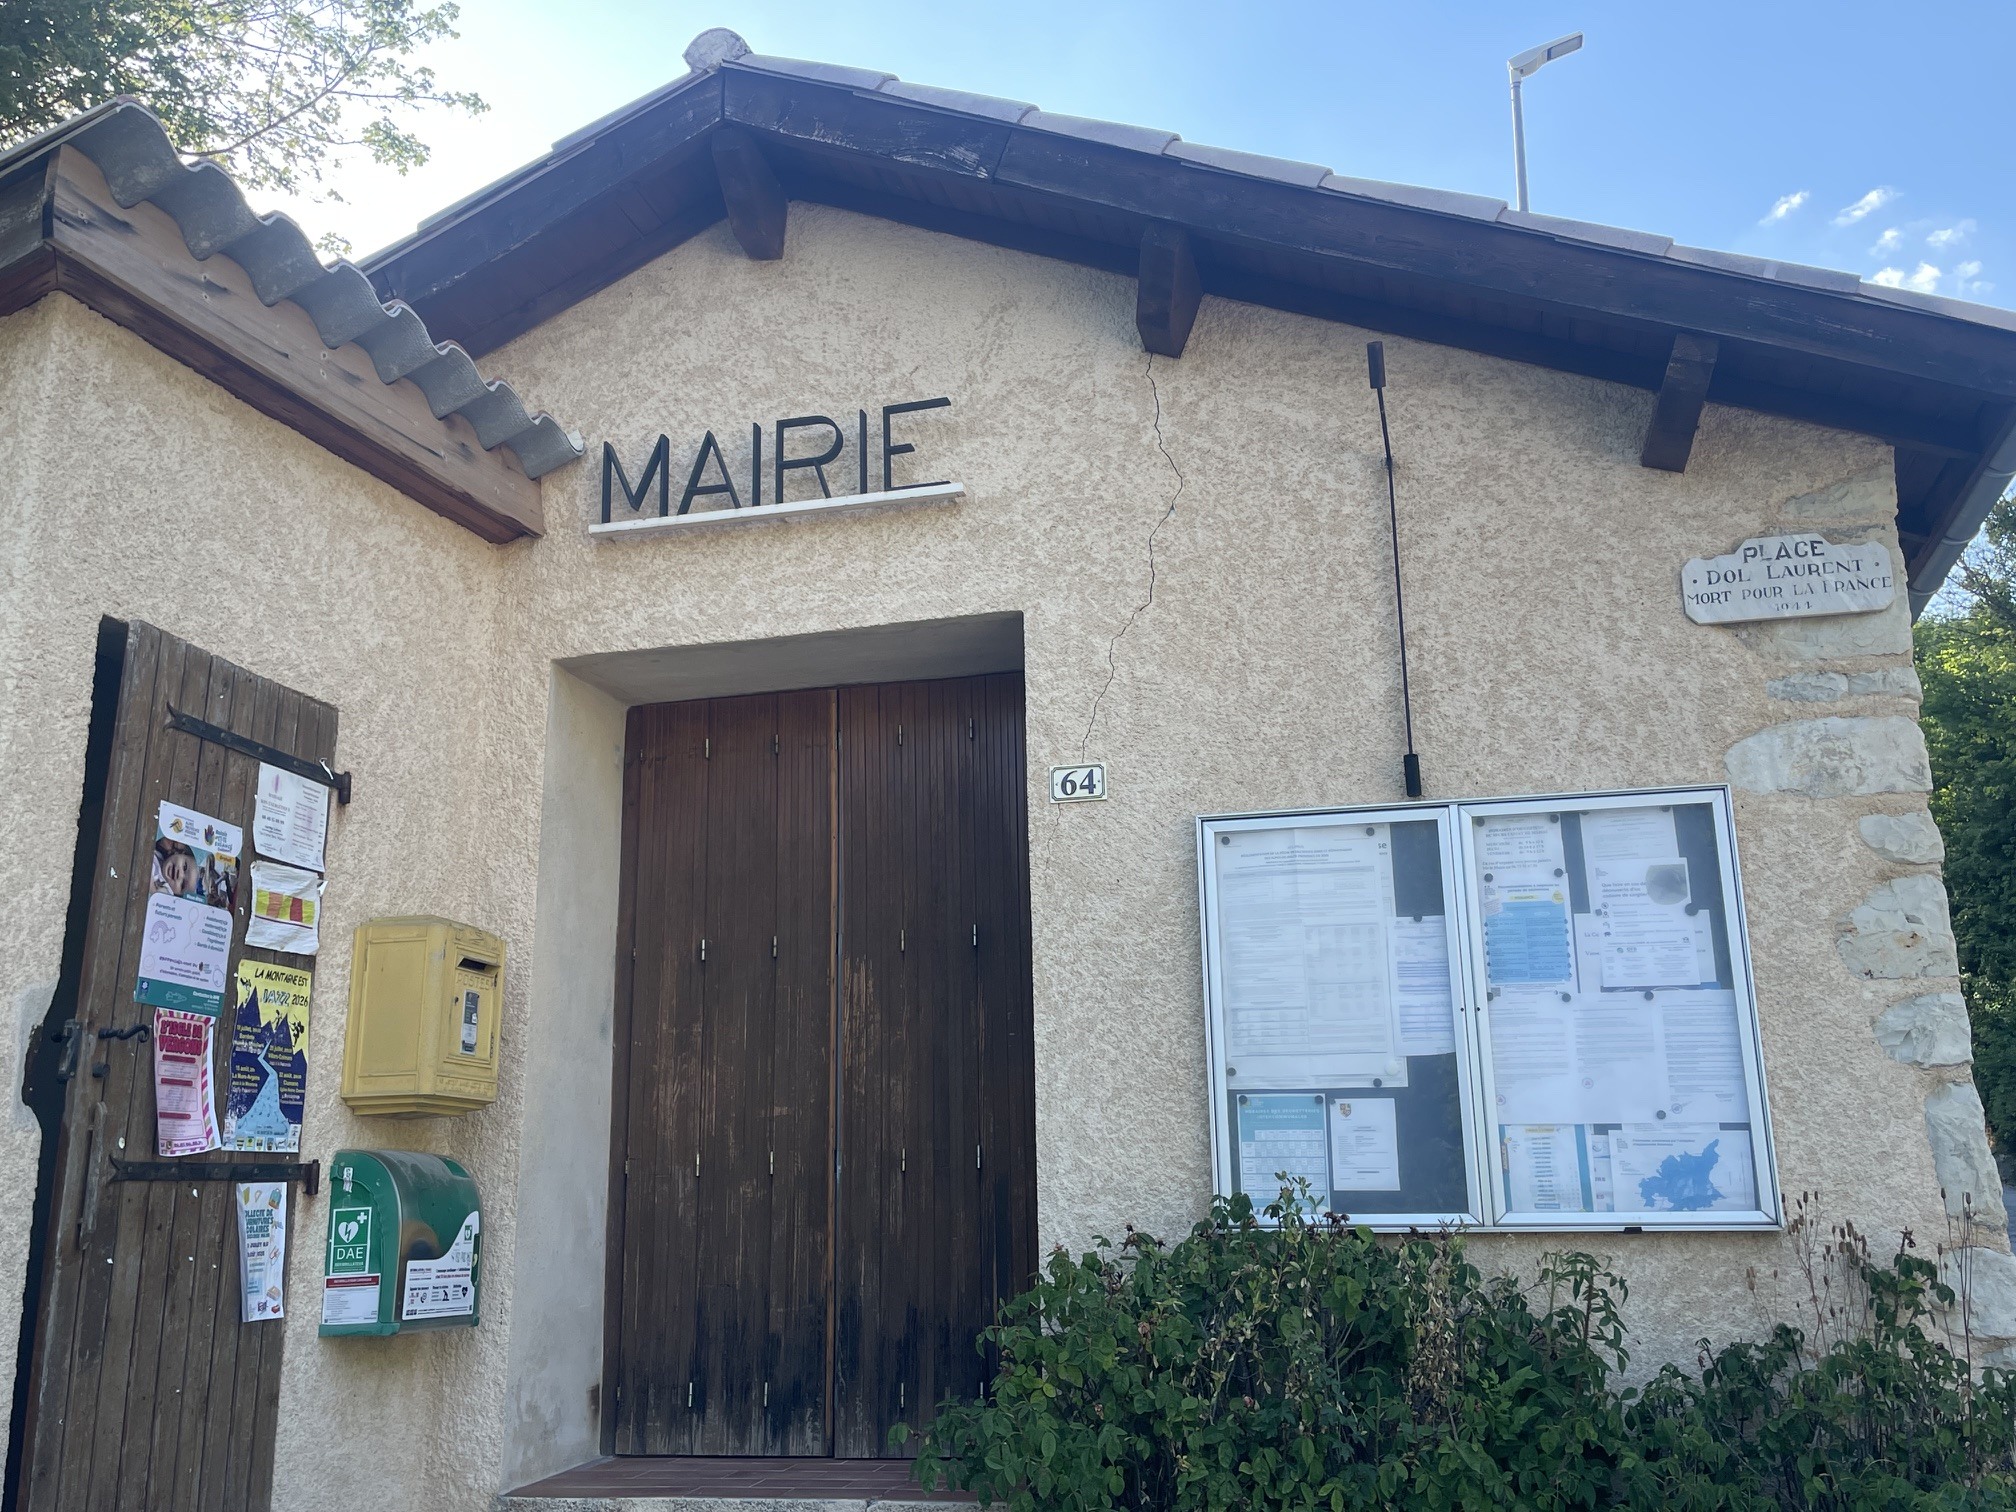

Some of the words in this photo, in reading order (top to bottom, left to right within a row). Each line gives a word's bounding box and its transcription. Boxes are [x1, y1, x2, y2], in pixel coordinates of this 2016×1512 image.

[602, 397, 951, 523] MAIRIE
[1743, 541, 1824, 563] PLACE
[1707, 569, 1750, 585] DOL
[1766, 559, 1863, 579] LAURENT
[1687, 590, 1732, 605] MORT
[1742, 586, 1783, 600] POUR
[1794, 583, 1814, 596] LA
[1061, 769, 1096, 796] 64
[254, 968, 265, 978] LA
[265, 970, 298, 986] MONTAGNE
[298, 976, 308, 987] EST
[456, 973, 491, 990] POSTES
[291, 994, 309, 1007] 2026
[266, 1208, 273, 1216] DE
[336, 1247, 364, 1260] DAE
